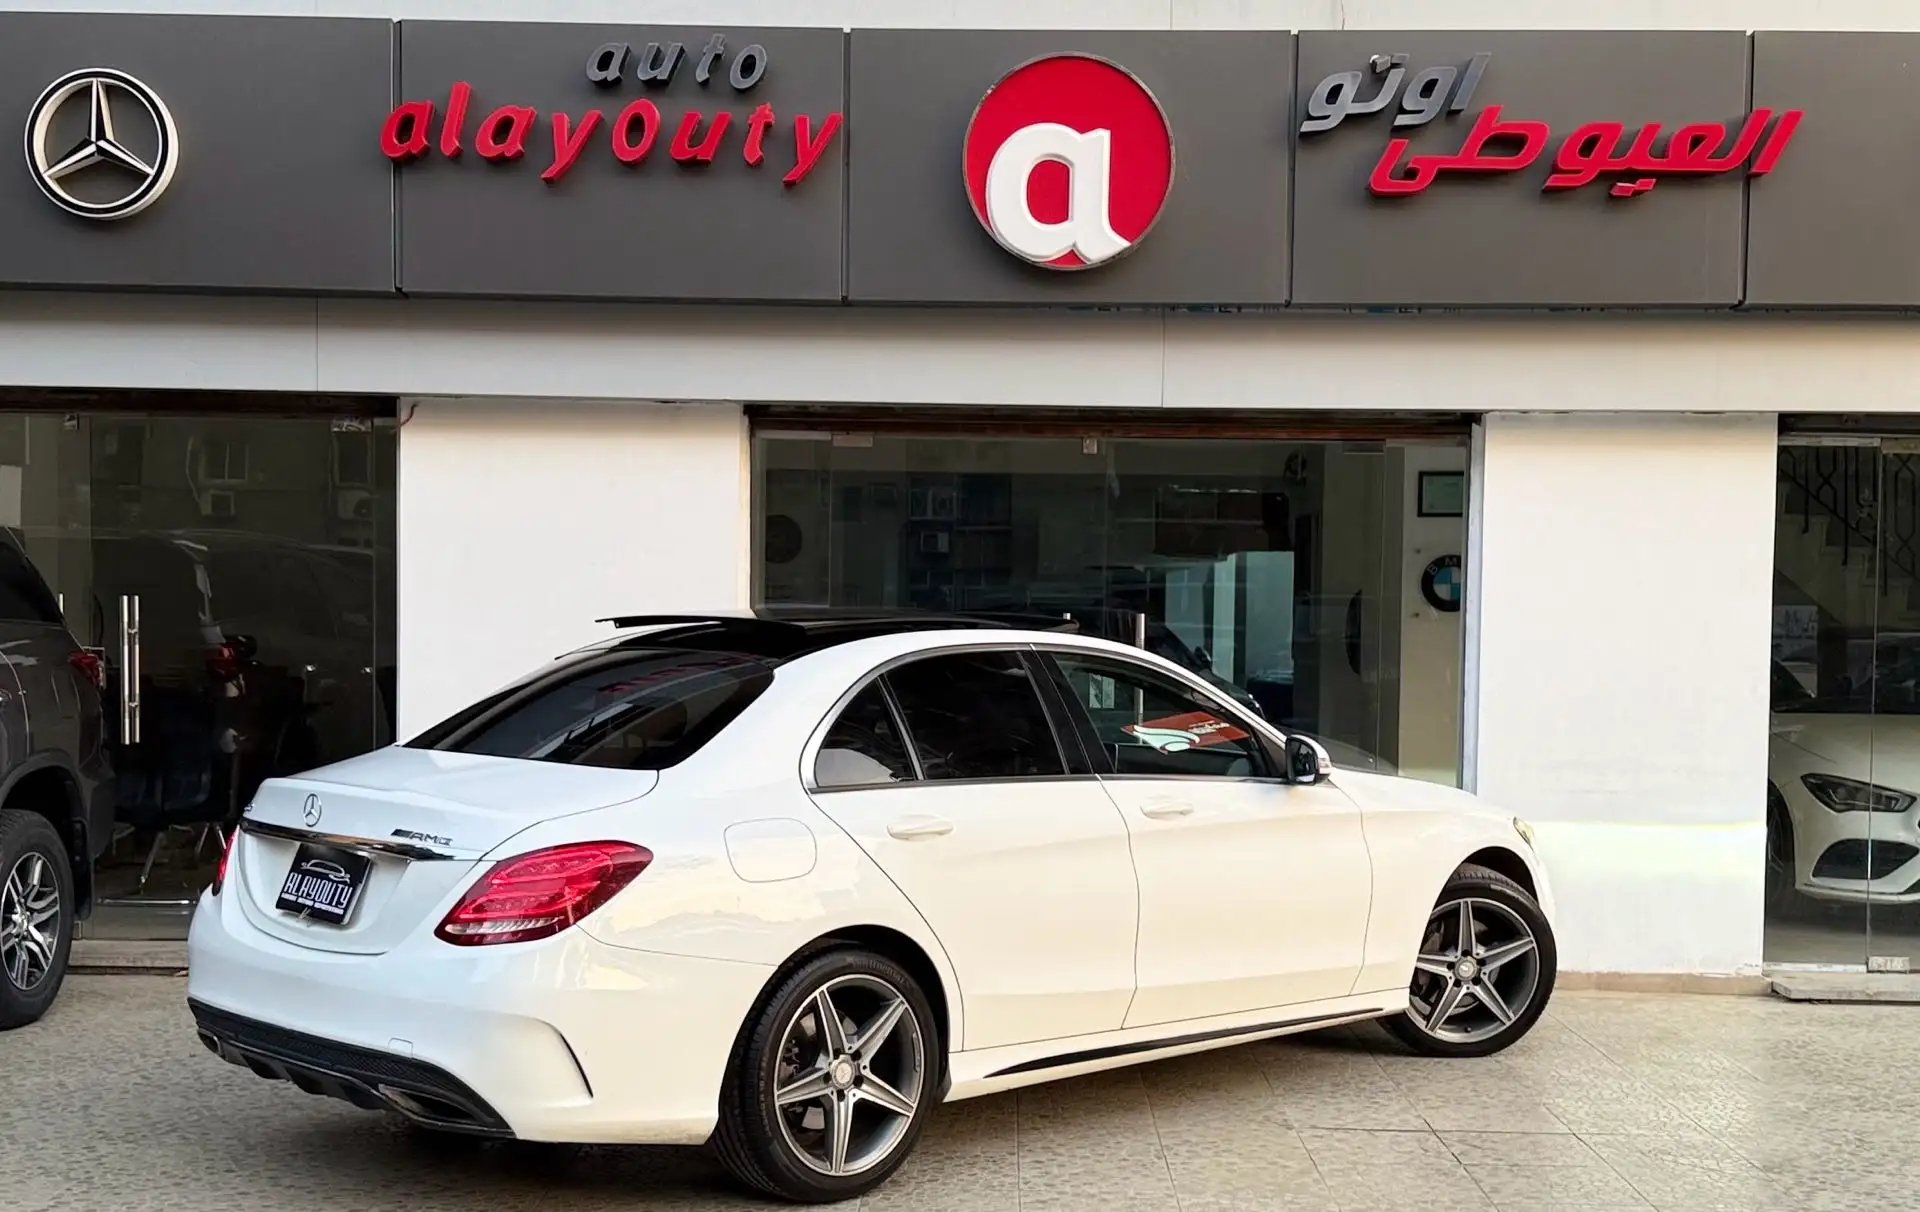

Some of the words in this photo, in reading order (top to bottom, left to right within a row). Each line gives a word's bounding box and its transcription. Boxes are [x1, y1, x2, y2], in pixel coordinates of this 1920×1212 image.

[587, 33, 768, 91] auto
[986, 122, 1132, 264] a
[409, 832, 454, 846] AMG
[283, 872, 353, 908] ALAYOUTY
